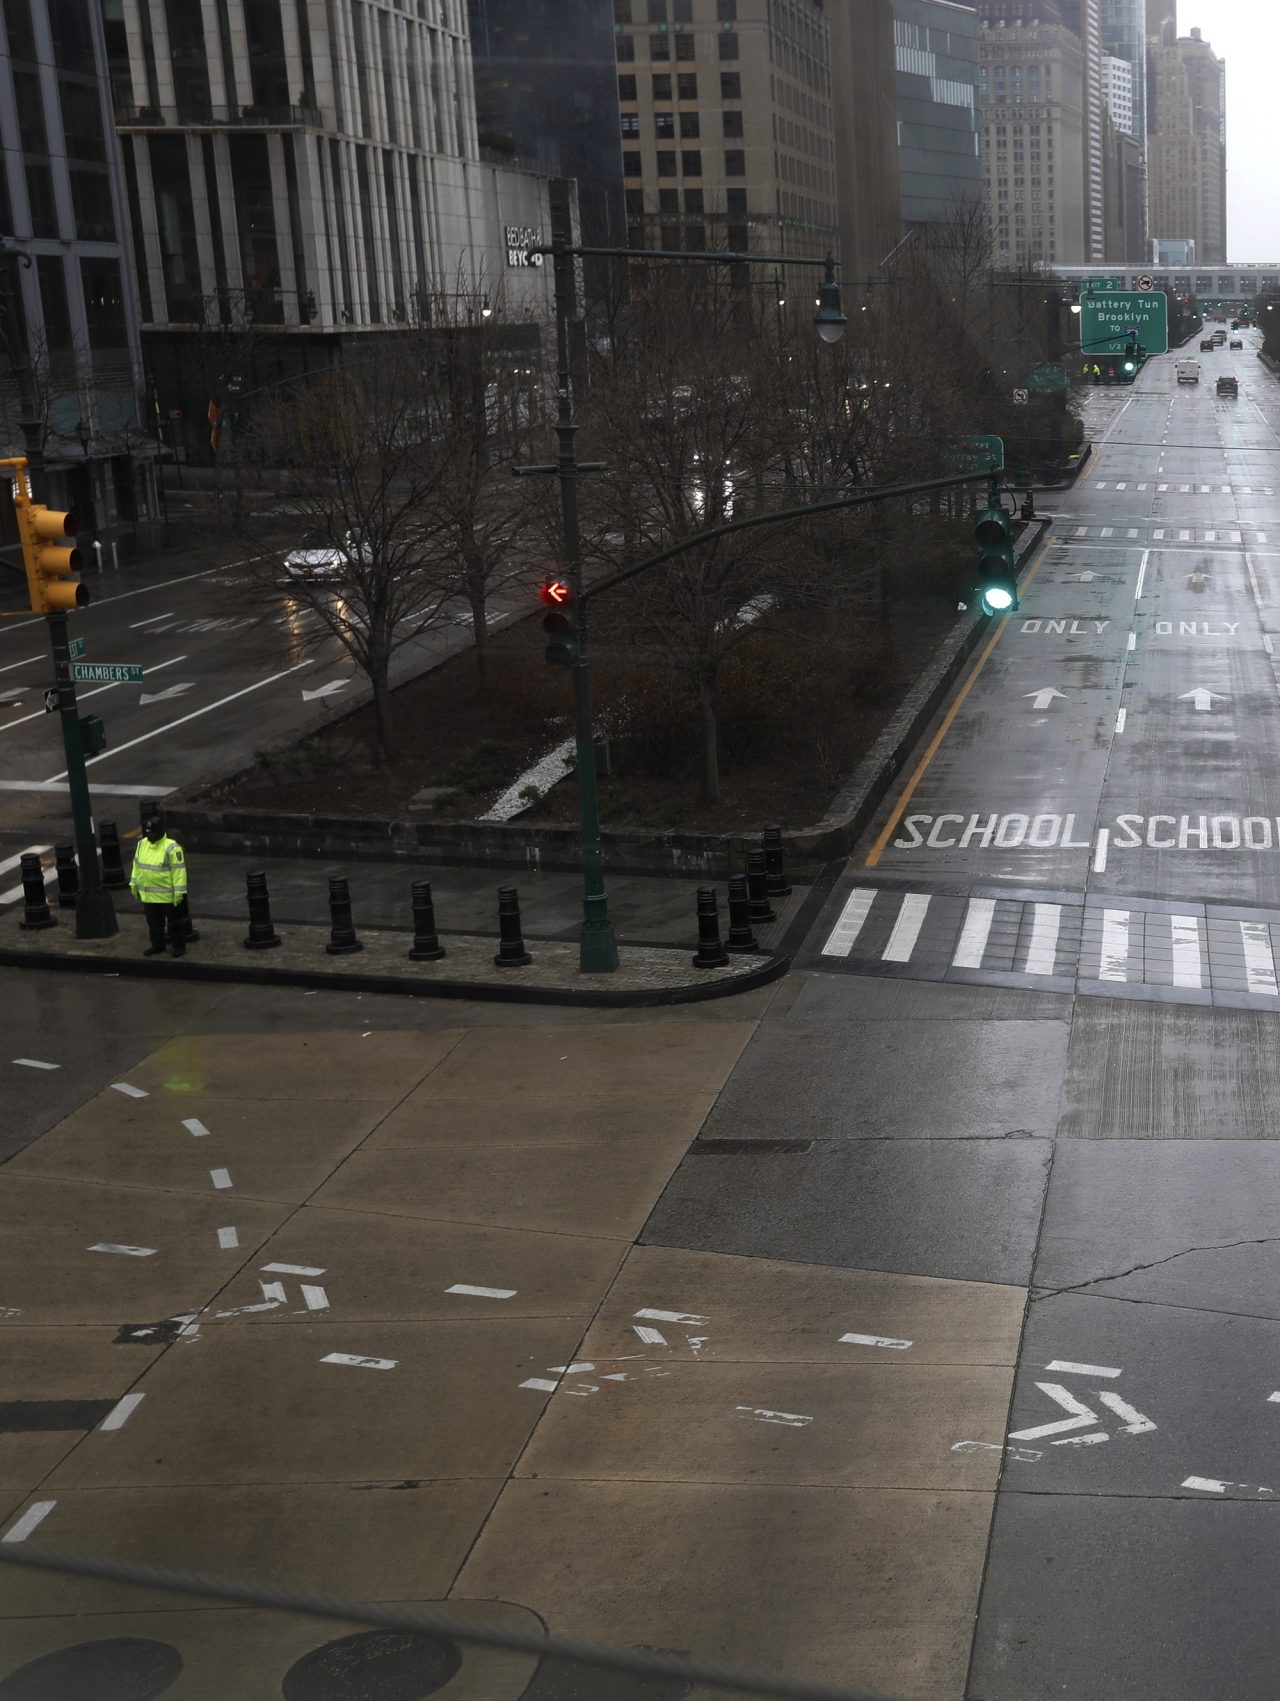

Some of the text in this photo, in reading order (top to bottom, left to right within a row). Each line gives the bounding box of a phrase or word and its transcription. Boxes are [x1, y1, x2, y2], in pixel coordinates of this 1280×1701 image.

[509, 250, 543, 266] BEYOD
[1106, 281, 1113, 289] 2
[1138, 300, 1159, 308] Tun
[1098, 313, 1149, 323] Brooklyn
[1020, 620, 1112, 634] ONLY
[1155, 621, 1240, 635] ONLY
[75, 666, 139, 681] CHAMBERS ST
[893, 813, 1090, 848] SCHOOL
